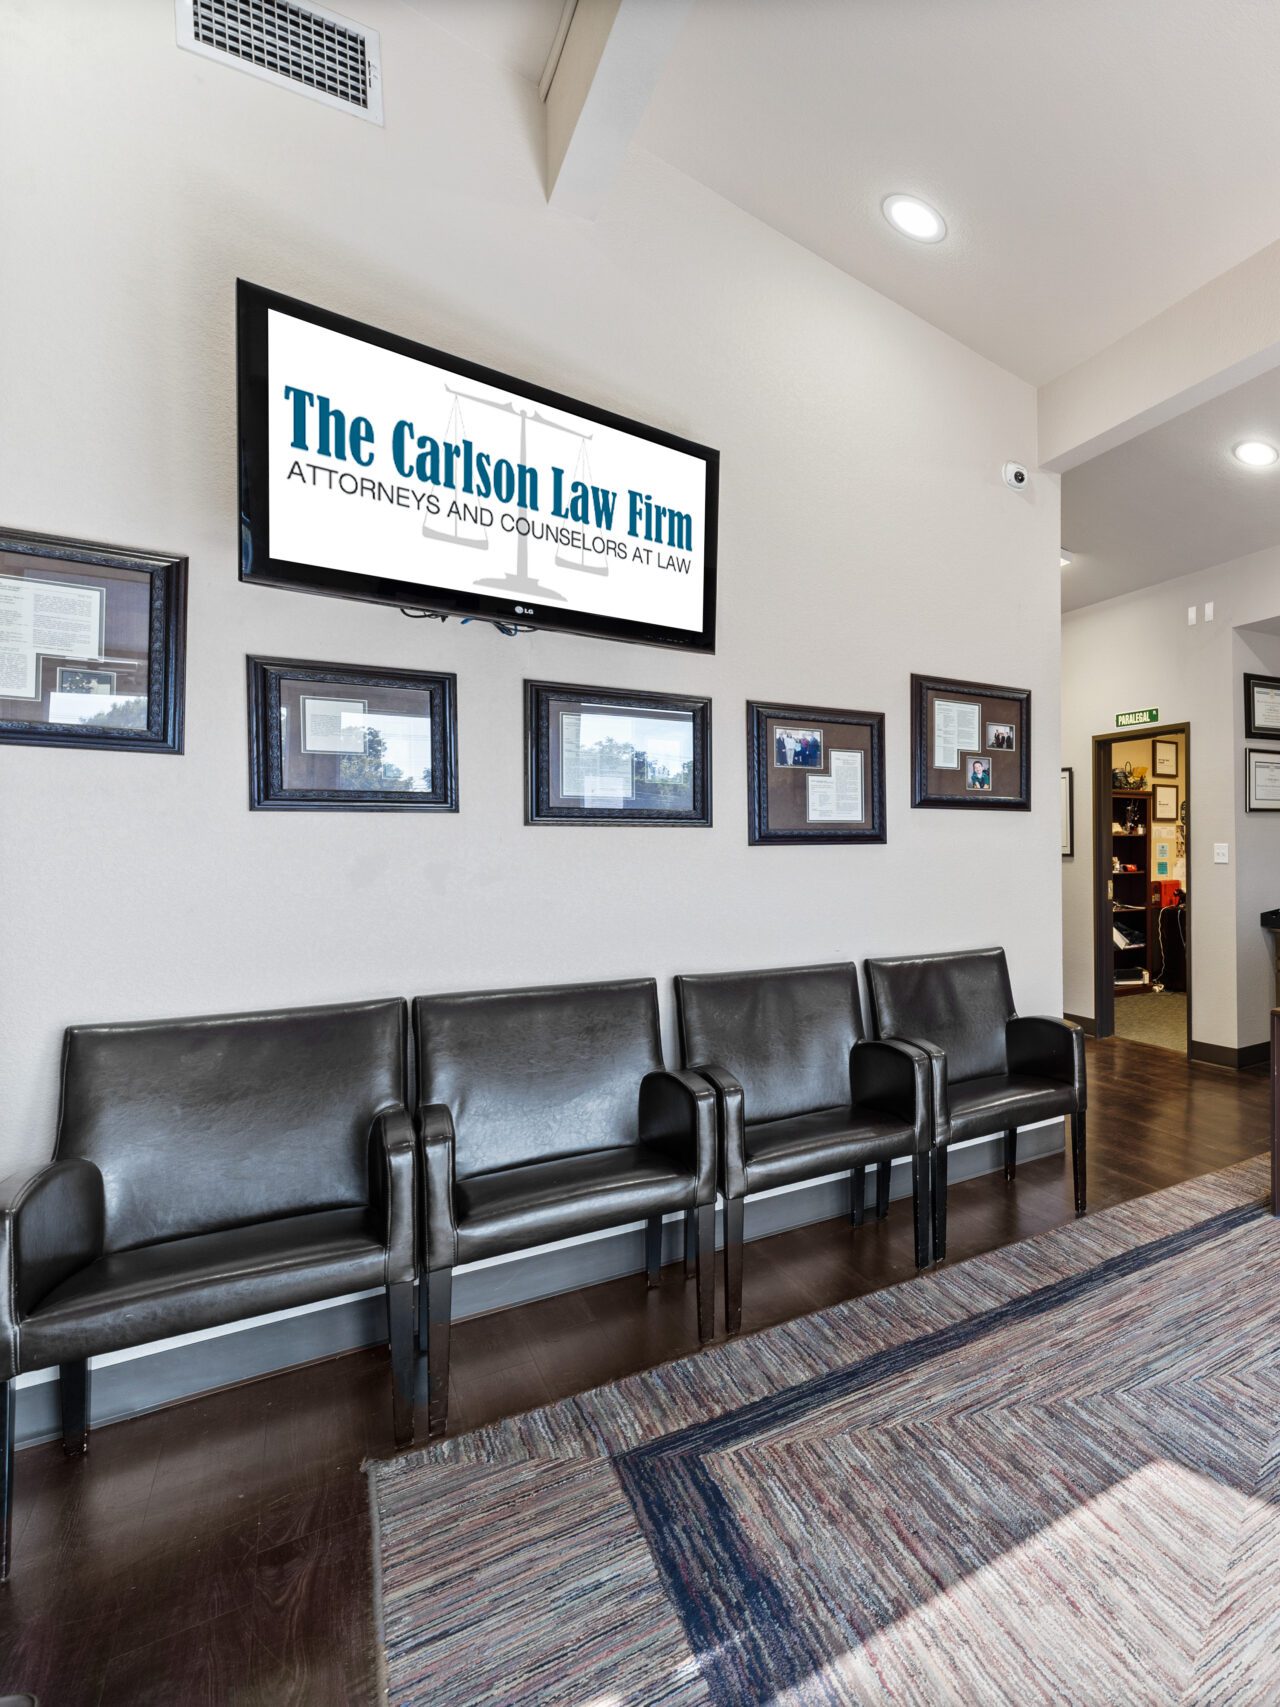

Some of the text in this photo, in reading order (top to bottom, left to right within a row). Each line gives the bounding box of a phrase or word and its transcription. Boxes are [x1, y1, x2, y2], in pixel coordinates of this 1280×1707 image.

[284, 385, 693, 552] The Carlson Law Firm
[287, 460, 691, 574] ATTORNEYS AND COUNSELORS AT LAW
[1118, 711, 1150, 727] PARALEGAL
